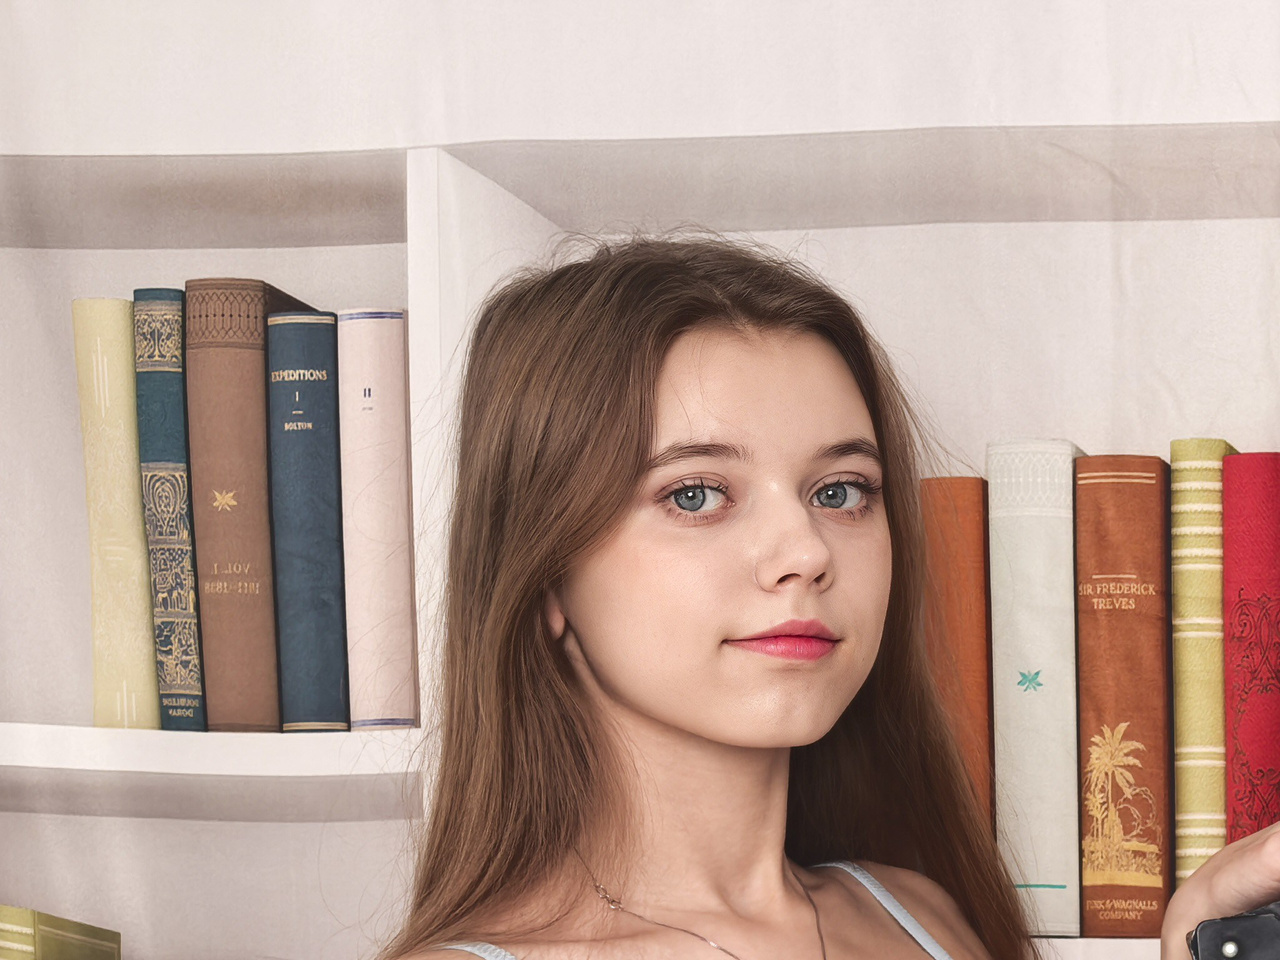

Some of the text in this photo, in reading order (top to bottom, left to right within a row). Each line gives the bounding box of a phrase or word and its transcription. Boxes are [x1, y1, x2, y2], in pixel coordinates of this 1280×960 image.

[271, 369, 328, 382] EXPEDITIONS
[1079, 582, 1156, 595] SIR FREDERICK
[1092, 597, 1136, 610] TREVES
